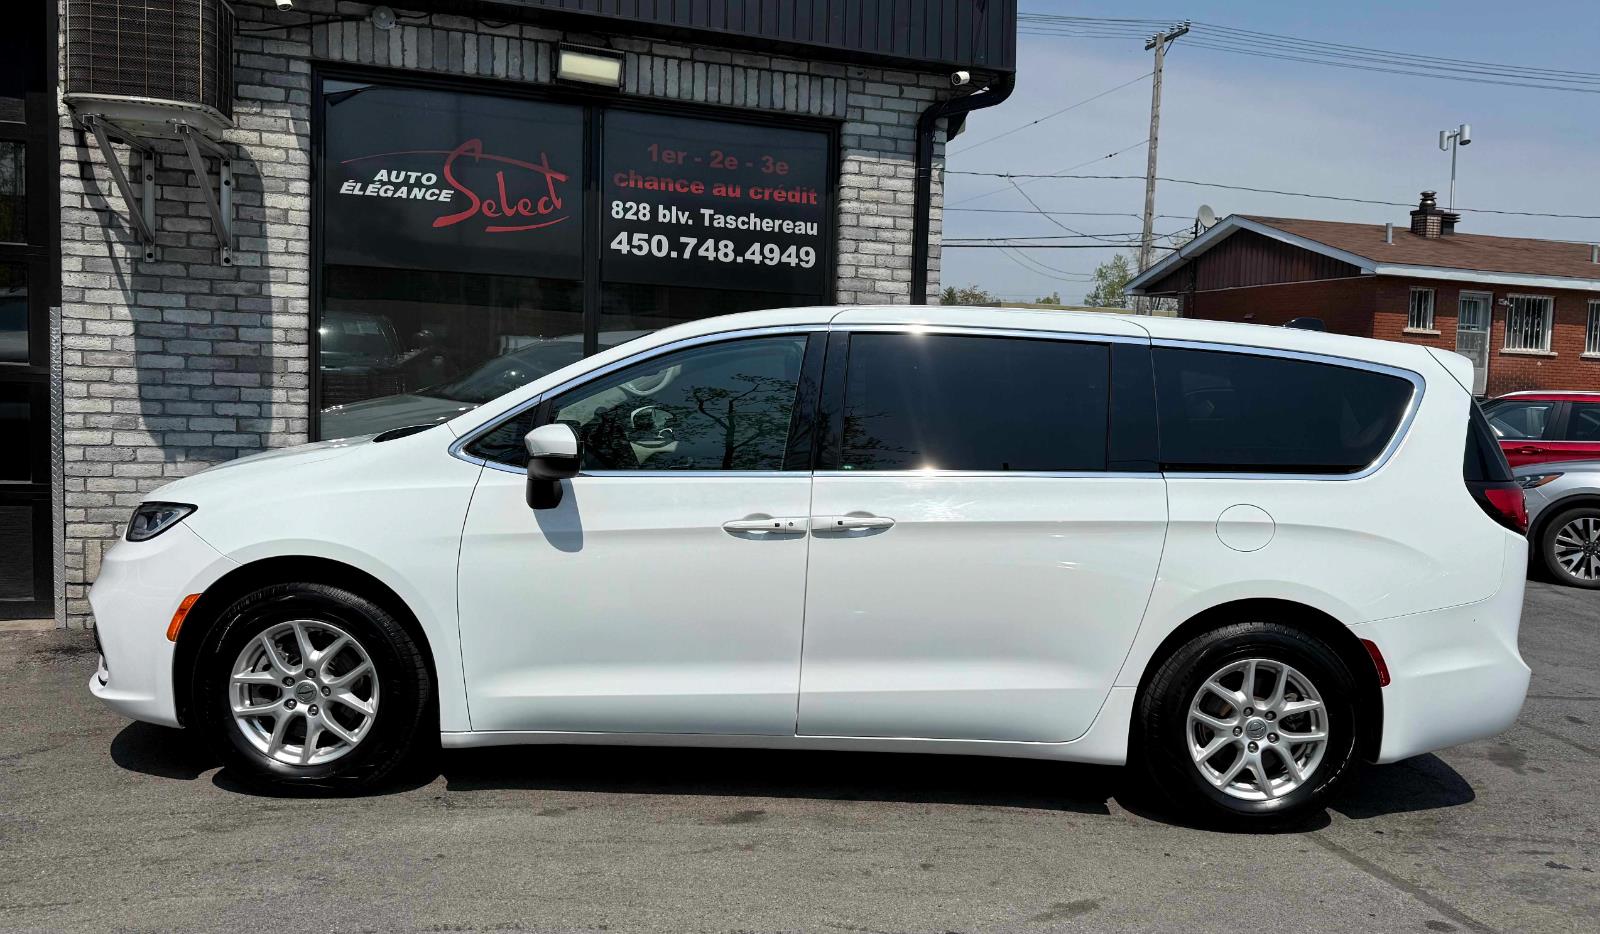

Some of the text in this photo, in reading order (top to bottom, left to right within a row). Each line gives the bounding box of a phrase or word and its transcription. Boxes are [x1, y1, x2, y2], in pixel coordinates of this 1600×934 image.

[373, 168, 438, 186] AUTO
[647, 143, 688, 165] 1er
[709, 149, 739, 170] 2e
[761, 155, 790, 175] 3e
[339, 179, 455, 202] ÉLÉGANCE
[431, 138, 569, 229] Select
[613, 169, 818, 205] chance au crédit
[611, 200, 818, 236] 828 blv. Taschereau
[610, 231, 816, 269] 450.748.4949
